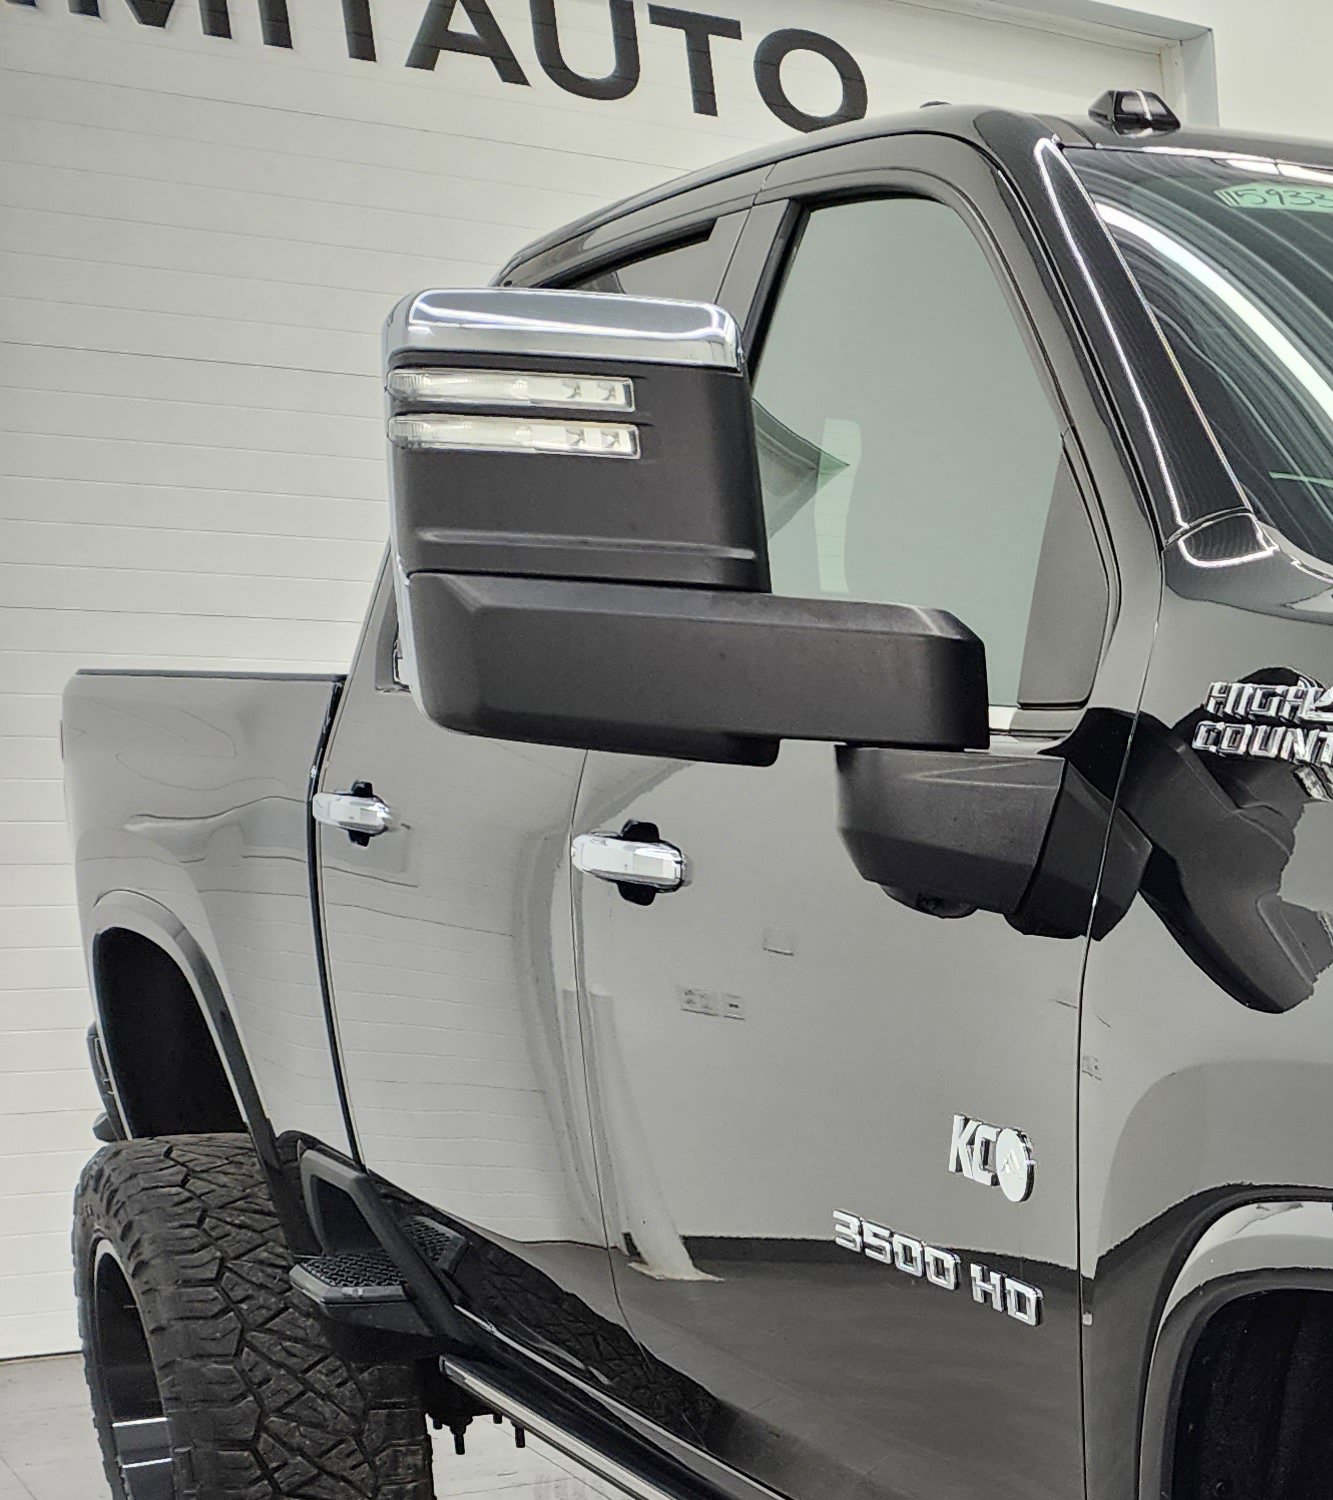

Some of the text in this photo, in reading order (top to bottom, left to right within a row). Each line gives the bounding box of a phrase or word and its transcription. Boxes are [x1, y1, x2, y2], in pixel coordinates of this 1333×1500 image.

[0, 0, 868, 133] AUTO
[1203, 680, 1325, 719] HIGH
[832, 1207, 1044, 1328] 3500 HD
